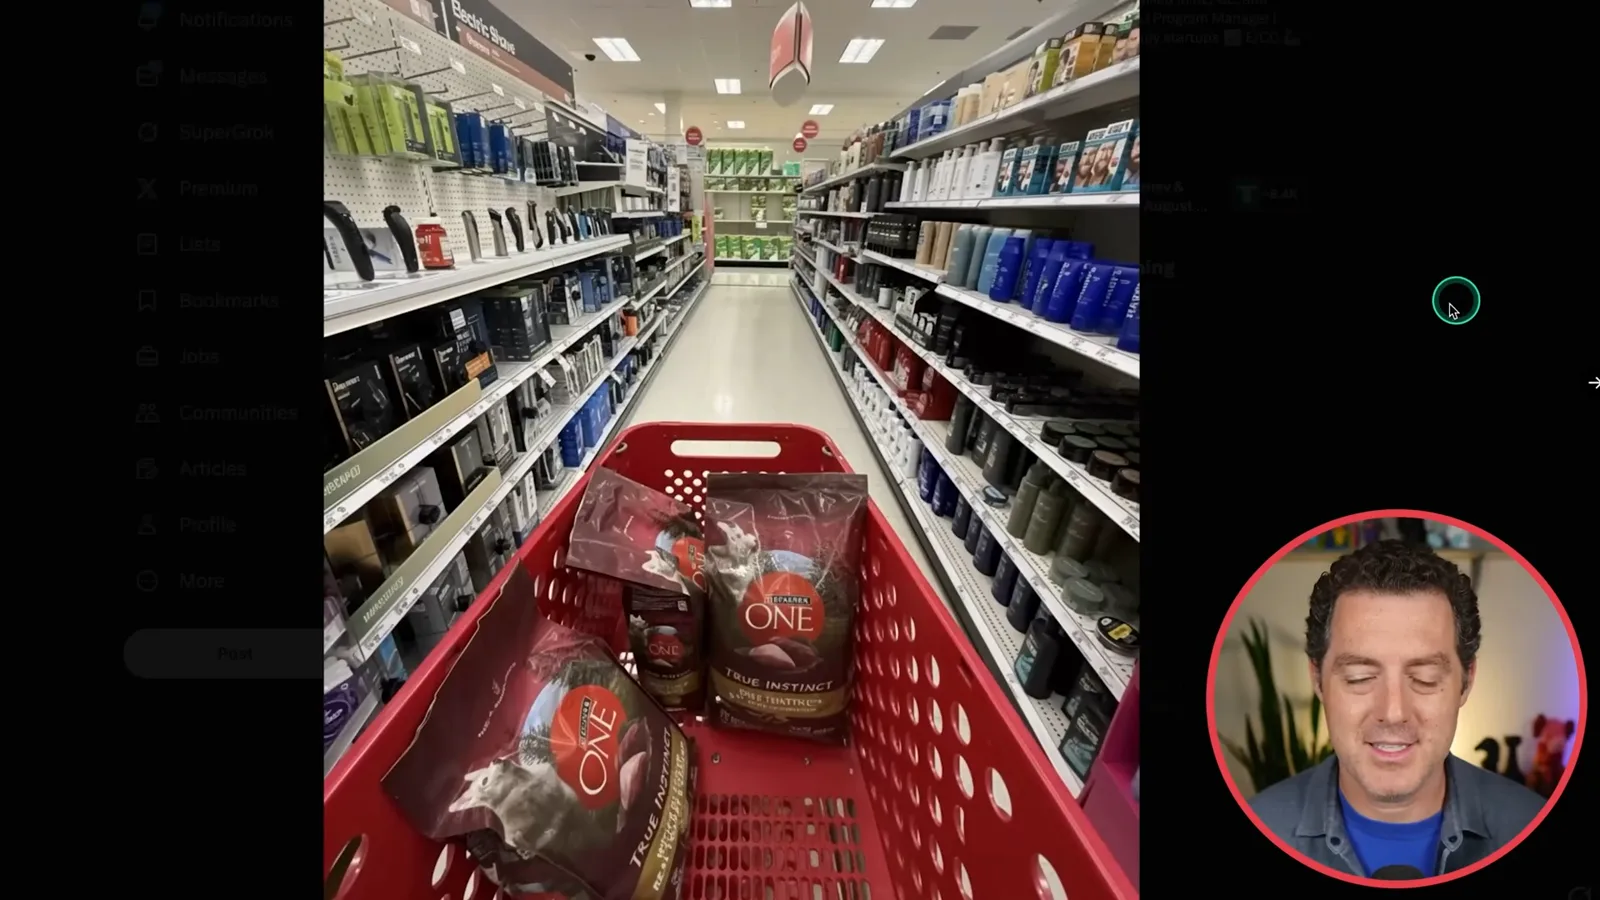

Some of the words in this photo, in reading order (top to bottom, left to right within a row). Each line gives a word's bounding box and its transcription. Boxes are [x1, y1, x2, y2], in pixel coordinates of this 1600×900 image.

[180, 11, 293, 28] Notifications
[1212, 12, 1269, 27] Manager
[180, 67, 268, 88] Messages
[180, 123, 274, 143] SuperGrok
[180, 180, 258, 197] Premium
[180, 235, 221, 252] Lists
[180, 291, 280, 309] Bookmarks
[180, 347, 220, 364] Jobs
[180, 404, 298, 421] Communities
[180, 460, 247, 477] Articles
[180, 516, 237, 533] Profile
[180, 573, 225, 589] More
[745, 603, 814, 632] ONE
[217, 646, 253, 661] Post
[649, 643, 680, 657] ONE
[725, 666, 760, 687] TRUE
[765, 680, 833, 693] INSTINCT
[579, 700, 618, 796] ONE
[629, 813, 659, 868] TRUE
[655, 726, 671, 811] INSTINCT
